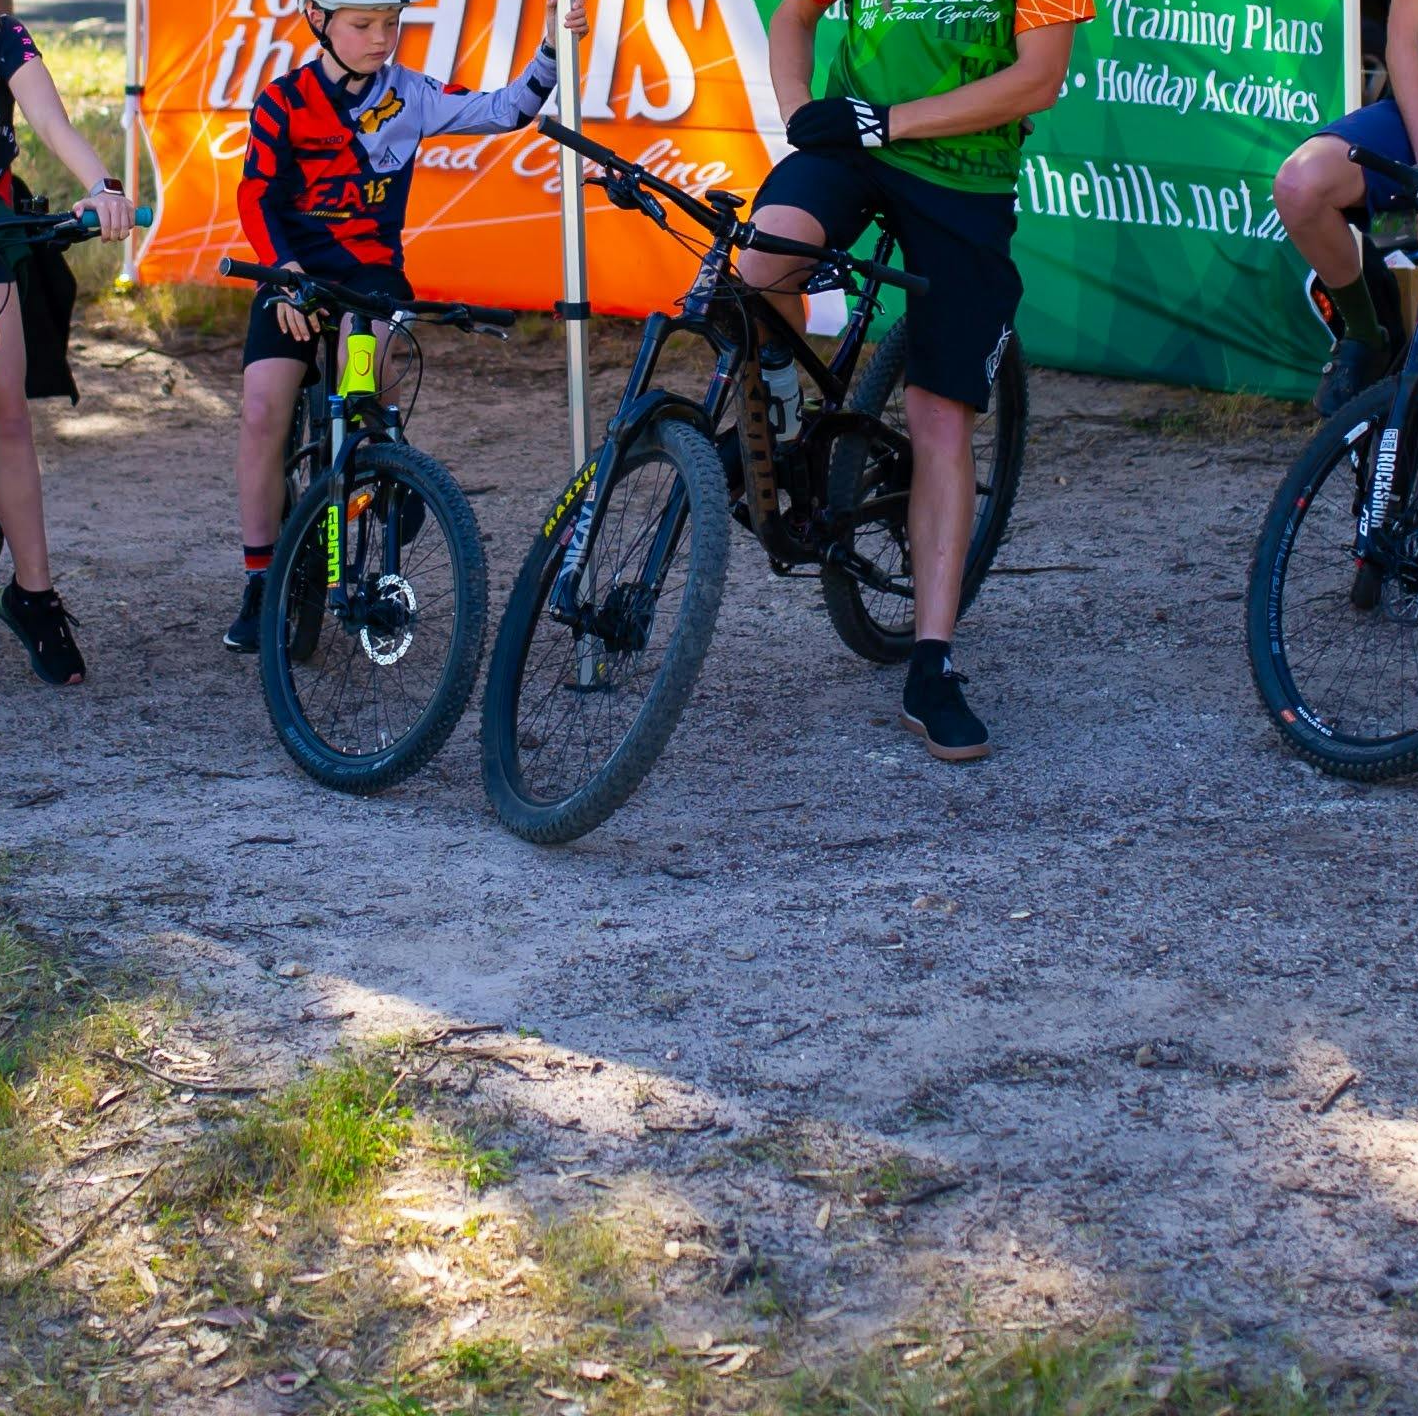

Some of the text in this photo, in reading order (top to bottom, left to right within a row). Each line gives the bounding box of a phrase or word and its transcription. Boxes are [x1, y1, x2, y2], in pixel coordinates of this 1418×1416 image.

[883, 5, 927, 22] Road
[934, 5, 1002, 26] Cycling
[206, 17, 322, 111] th
[1094, 58, 1197, 117] Holiday
[1203, 69, 1320, 126] Activities
